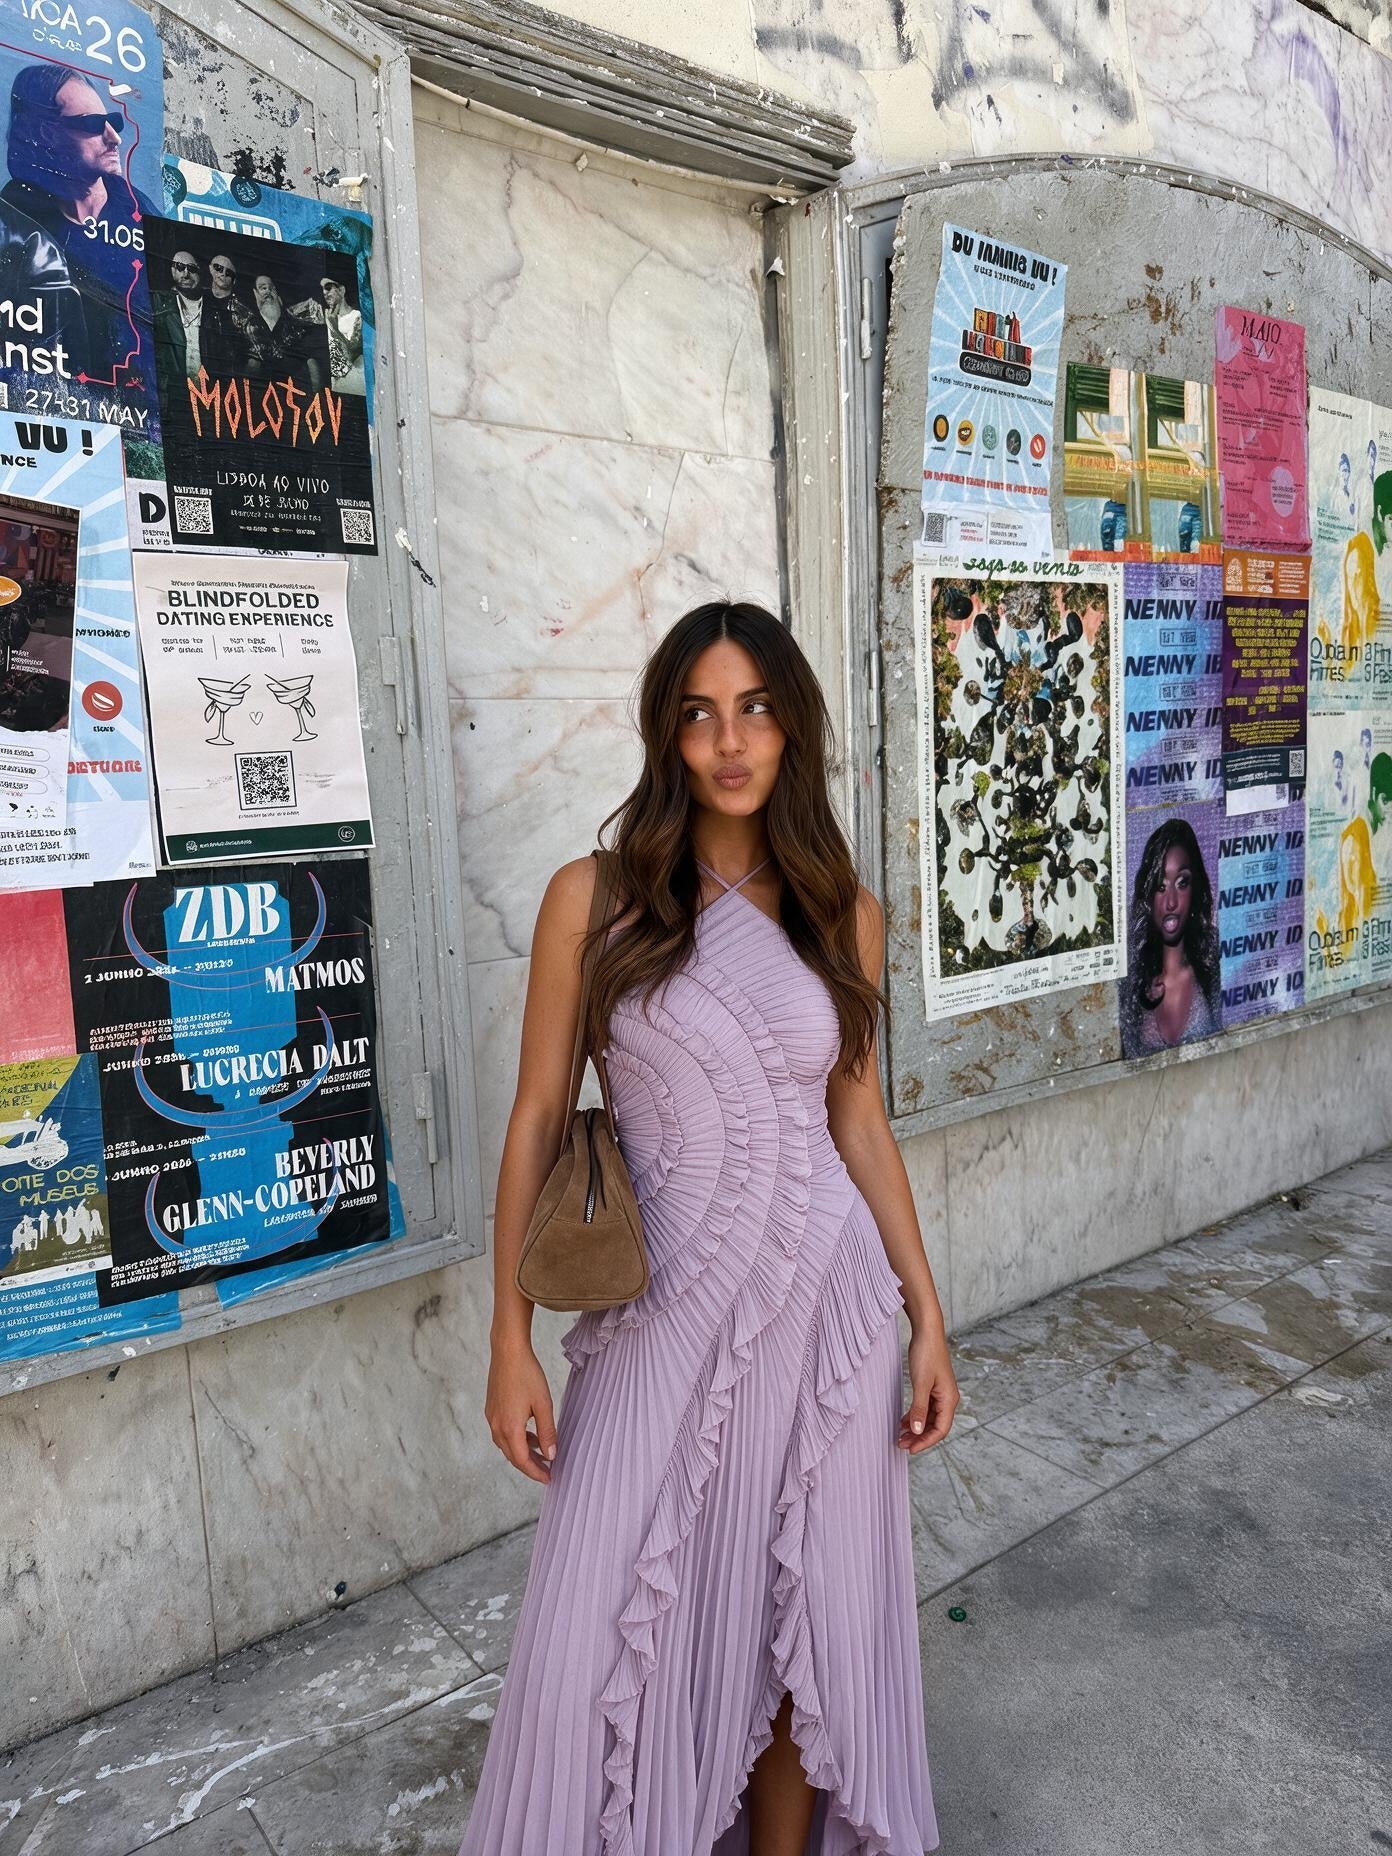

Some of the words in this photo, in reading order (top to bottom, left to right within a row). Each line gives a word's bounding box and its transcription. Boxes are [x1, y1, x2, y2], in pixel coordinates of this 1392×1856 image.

[86, 15, 146, 73] 26
[99, 400, 148, 429] MAY
[0, 454, 38, 468] NCE
[167, 589, 320, 609] BLINDFOLDED
[1124, 598, 1197, 620] NENNY
[156, 611, 226, 626] DATING
[1124, 654, 1197, 677] NENNY
[1125, 707, 1198, 733] NENNY
[1126, 760, 1197, 788] NENNY
[1218, 832, 1280, 859] NENNY
[1218, 880, 1280, 910] NENNY
[175, 883, 280, 943] ZDB
[1218, 929, 1279, 960] NENNY
[264, 956, 366, 994] MATMOS
[1220, 976, 1280, 1009] NENNY
[180, 1048, 304, 1092] LUCRECIA
[312, 1037, 370, 1071] DALT
[274, 1134, 374, 1178] BEVERLY
[56, 1164, 99, 1183] DOS
[19, 1182, 99, 1207] MUSEUS
[162, 1163, 377, 1233] GLENN-COPELAND
